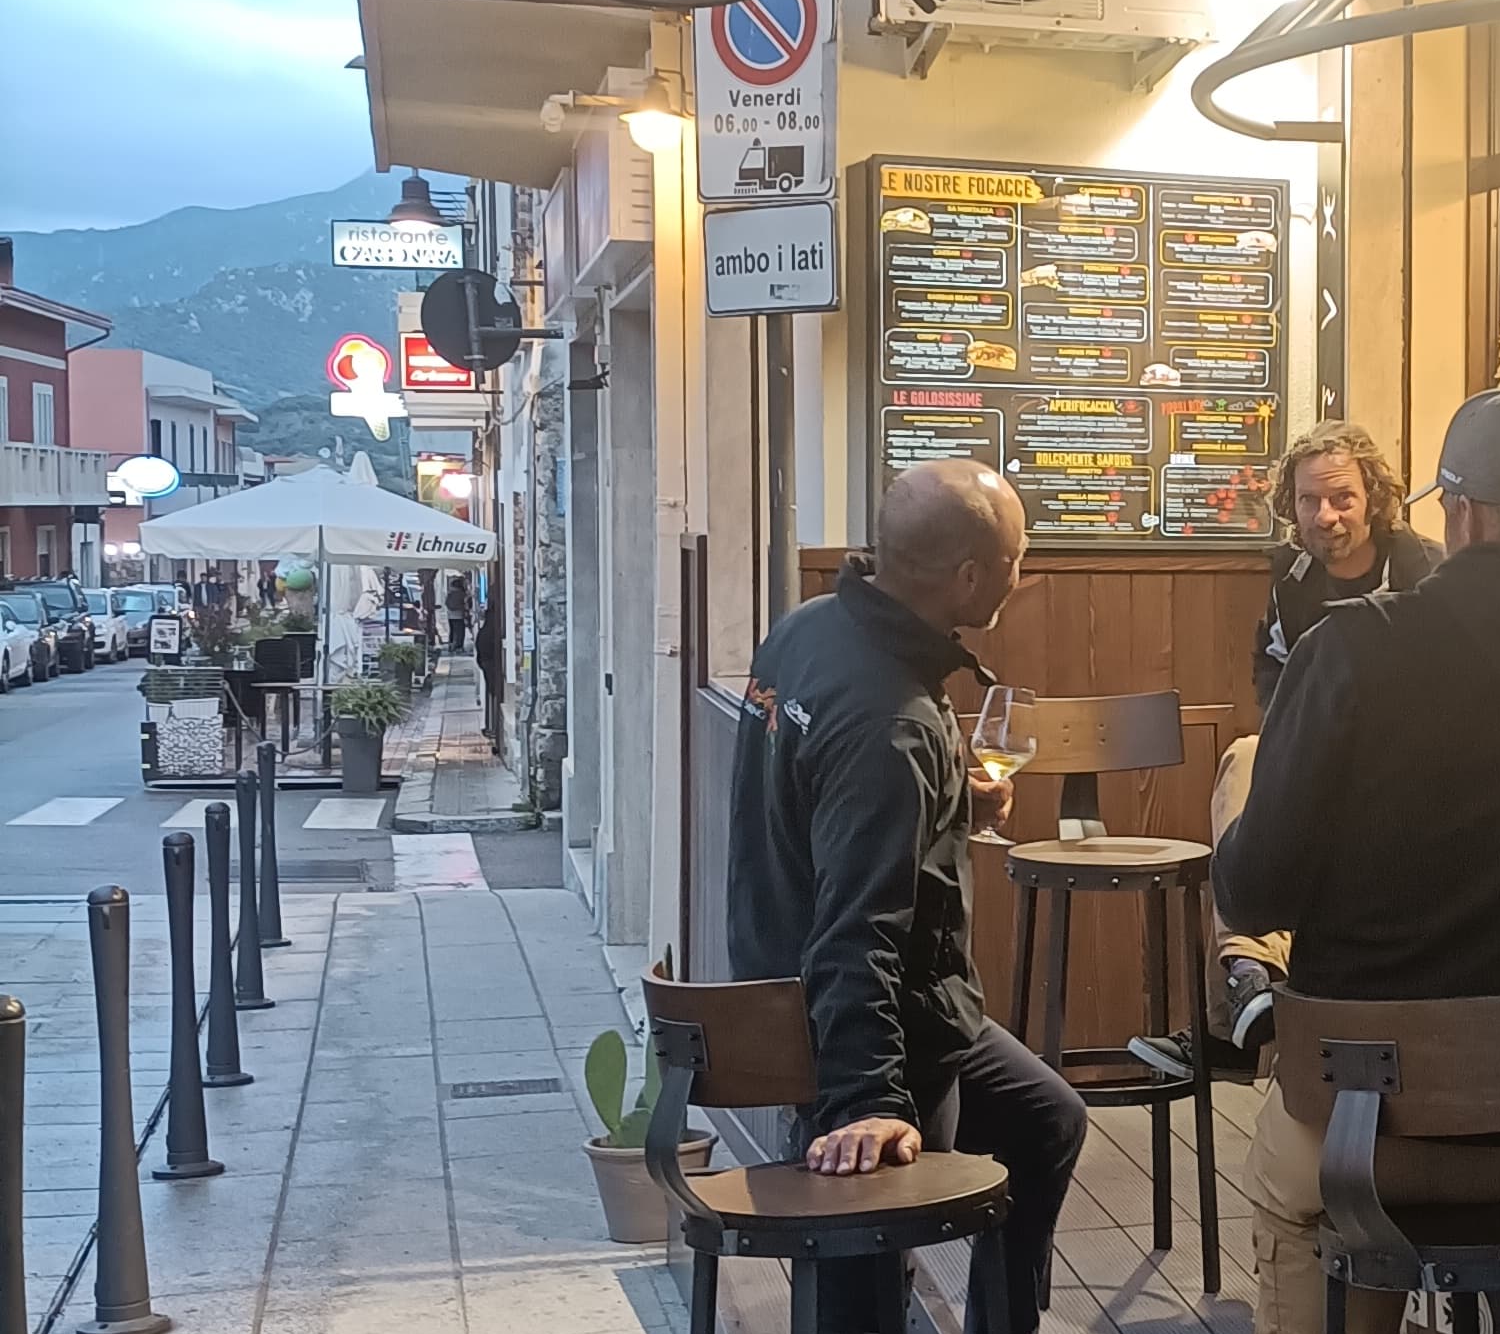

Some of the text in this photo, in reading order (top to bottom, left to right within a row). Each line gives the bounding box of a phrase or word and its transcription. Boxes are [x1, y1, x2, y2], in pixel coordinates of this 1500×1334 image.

[903, 172, 961, 194] NOSTRE
[968, 176, 1033, 198] FOCACCE
[348, 226, 449, 245] ristorante
[715, 241, 824, 276] ambo i lati
